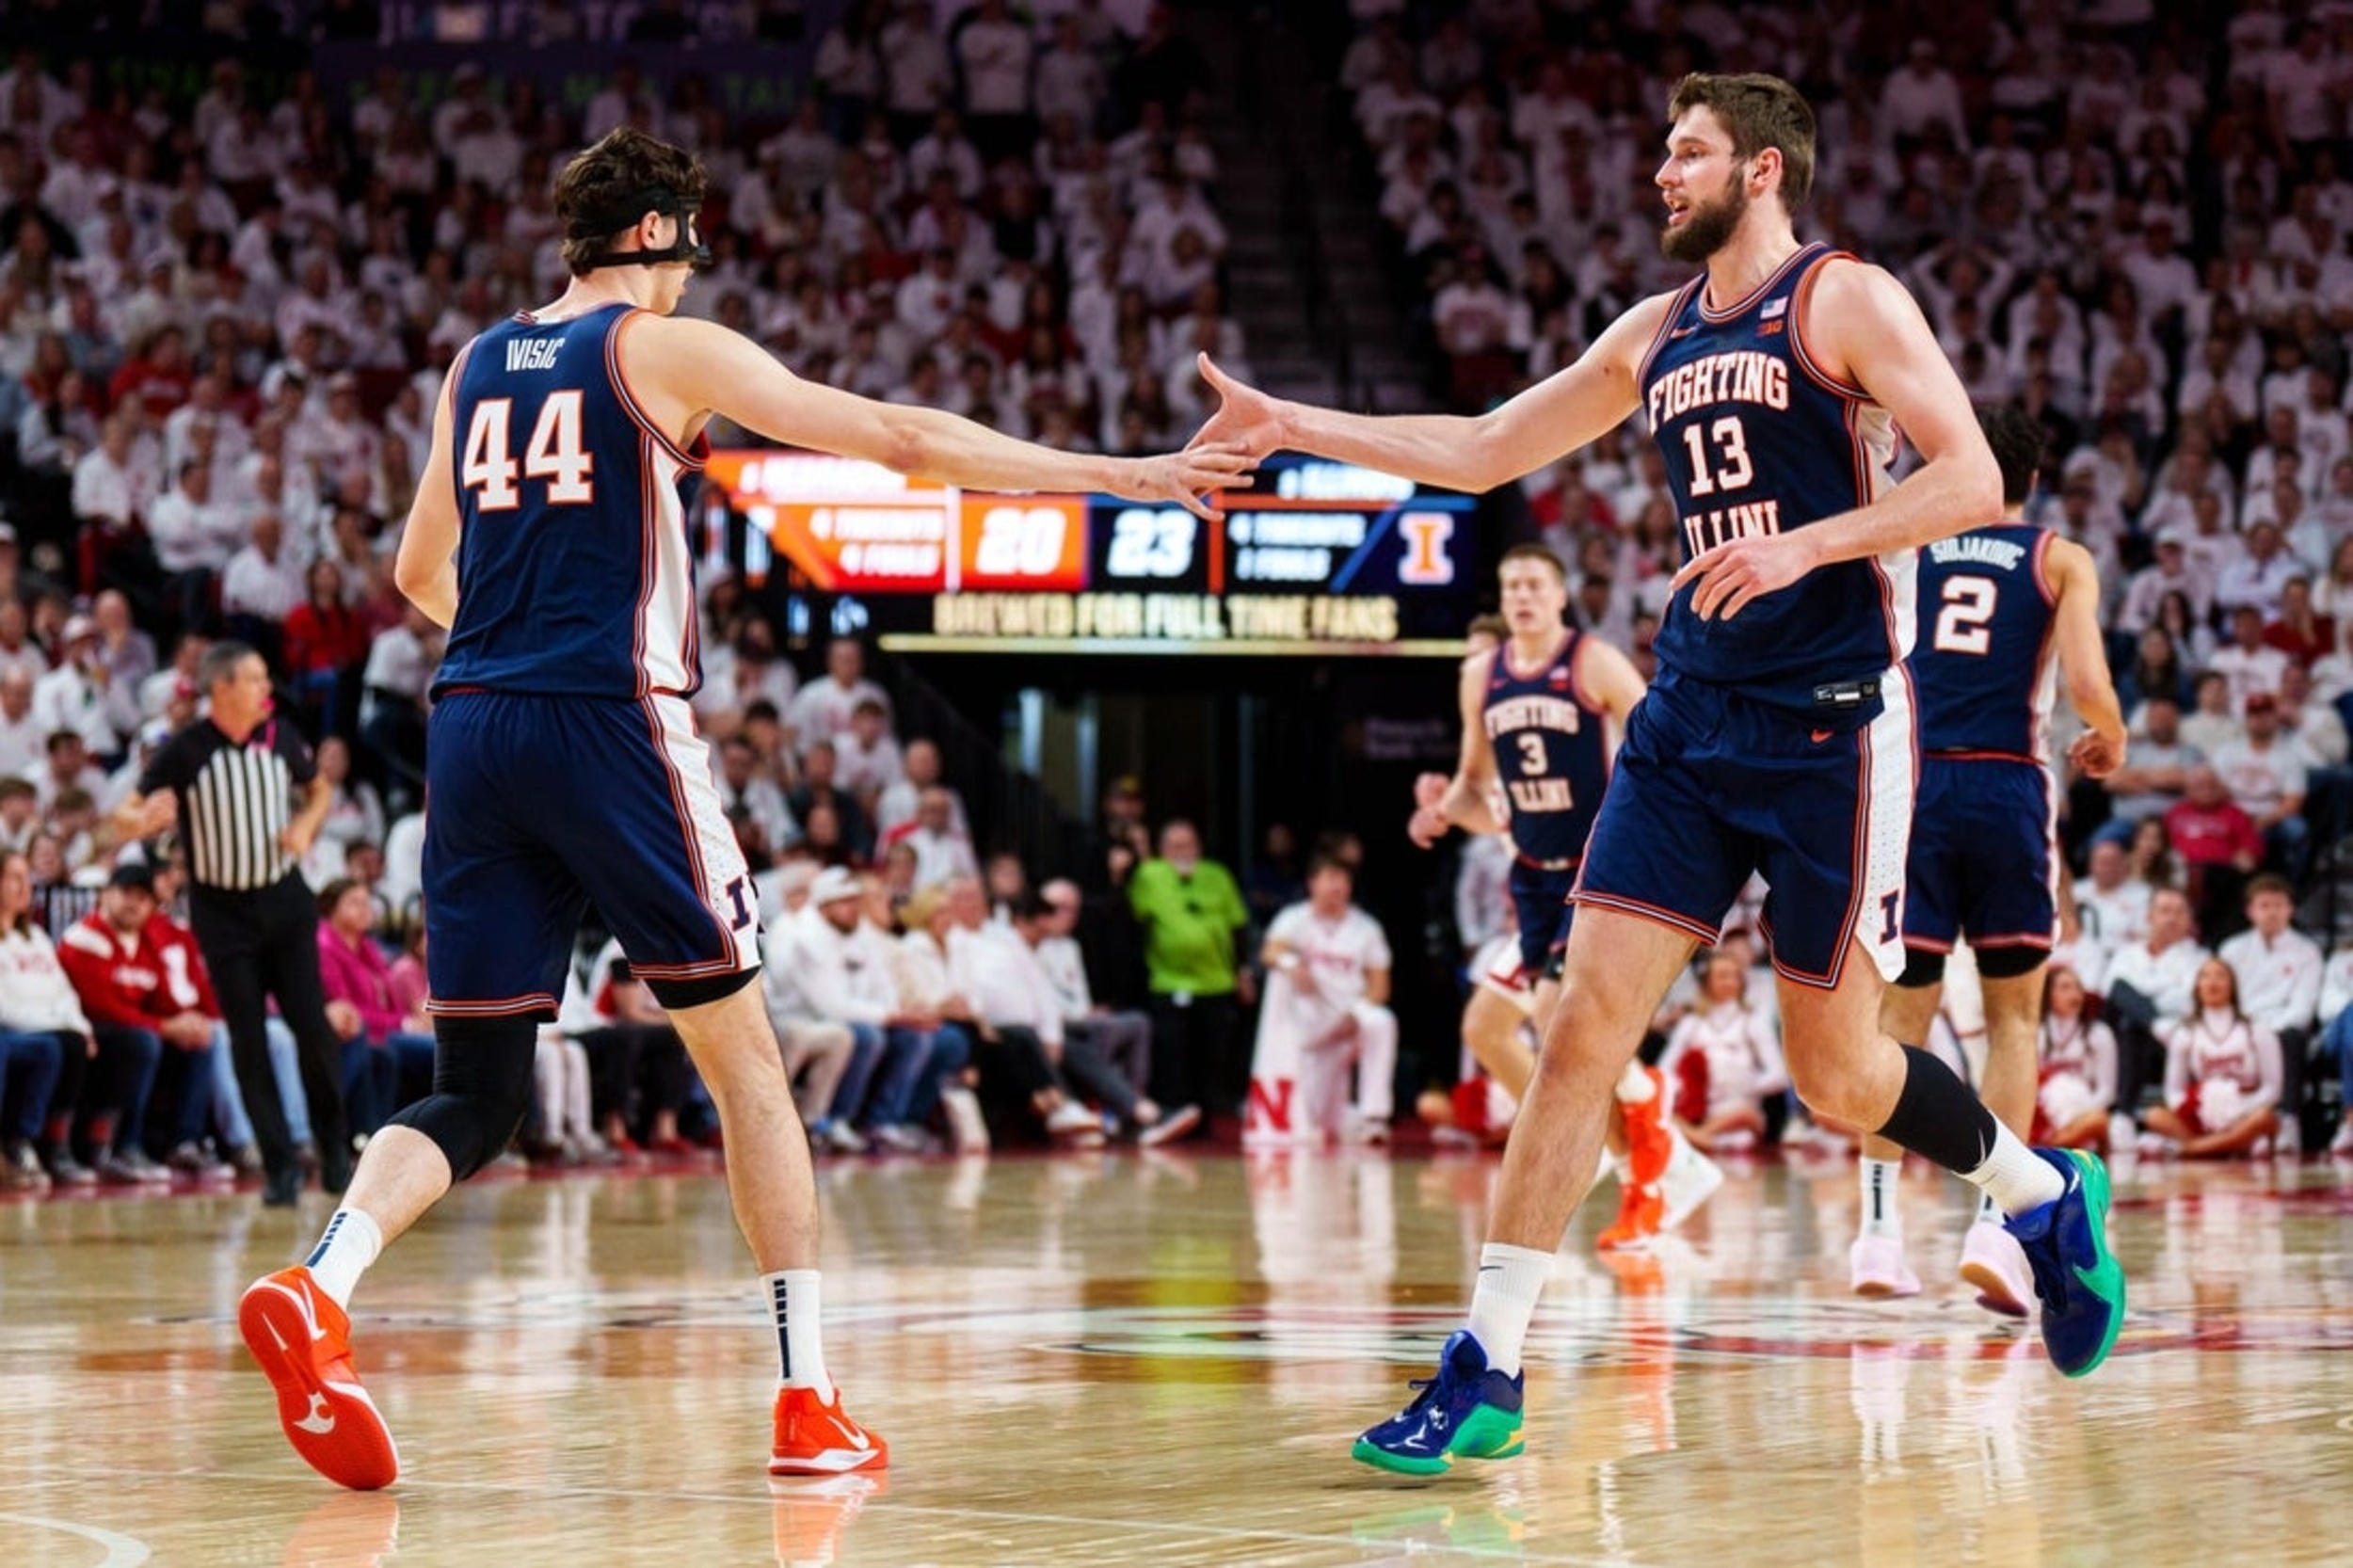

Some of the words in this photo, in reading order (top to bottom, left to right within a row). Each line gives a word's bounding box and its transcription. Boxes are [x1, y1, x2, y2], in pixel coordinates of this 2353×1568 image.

[505, 338, 566, 372] IVISIC
[1649, 351, 1789, 436] FIGHTING
[463, 390, 594, 513] 44
[1683, 416, 1754, 497] 13
[975, 507, 1066, 576] 20
[1106, 509, 1197, 577] 23
[935, 594, 1073, 636] BREWED
[1077, 594, 1143, 636] FOR
[1145, 594, 1224, 639] FULL
[1227, 596, 1307, 640] TIME
[1311, 596, 1398, 641] FANS
[1934, 575, 1997, 656] 2
[1516, 732, 1548, 776] 3
[1243, 1078, 1294, 1132] N
